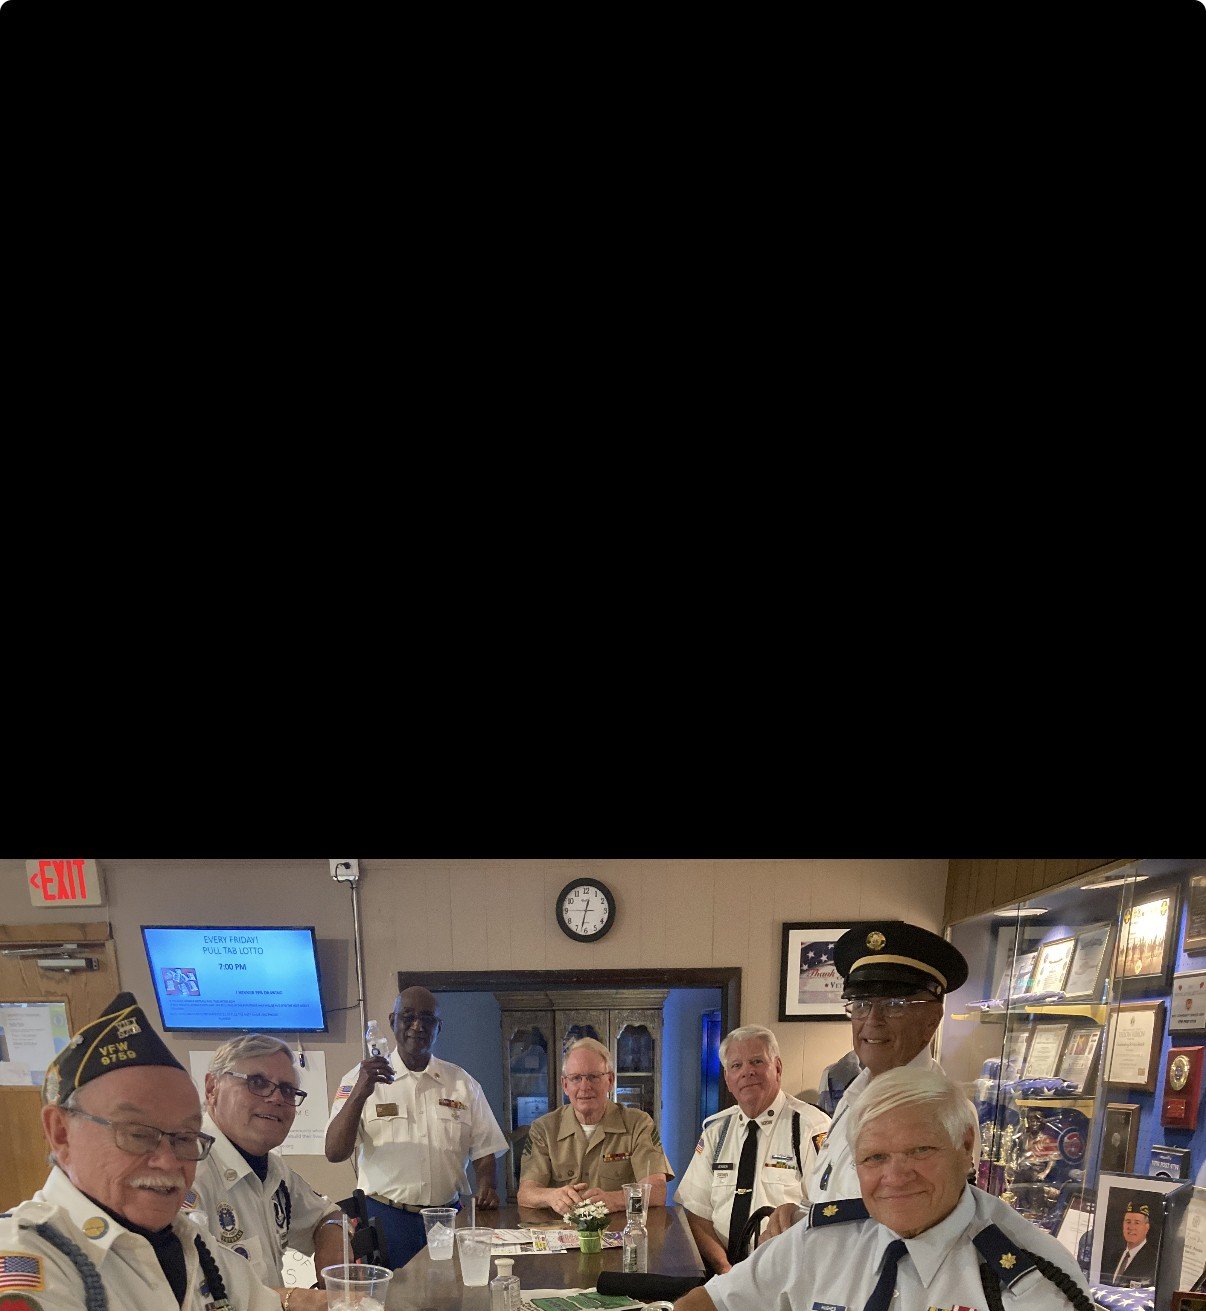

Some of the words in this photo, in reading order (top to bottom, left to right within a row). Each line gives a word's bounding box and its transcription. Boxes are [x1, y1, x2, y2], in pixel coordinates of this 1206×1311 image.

[39, 860, 87, 900] EXIT
[203, 935, 227, 944] EVERY
[202, 946, 222, 955] PULL
[222, 946, 238, 955] TAB
[239, 946, 264, 955] LOTTO
[219, 963, 234, 971] 7:00
[235, 963, 247, 971] PM
[98, 1041, 129, 1056] VFW
[101, 1050, 137, 1066] 9759
